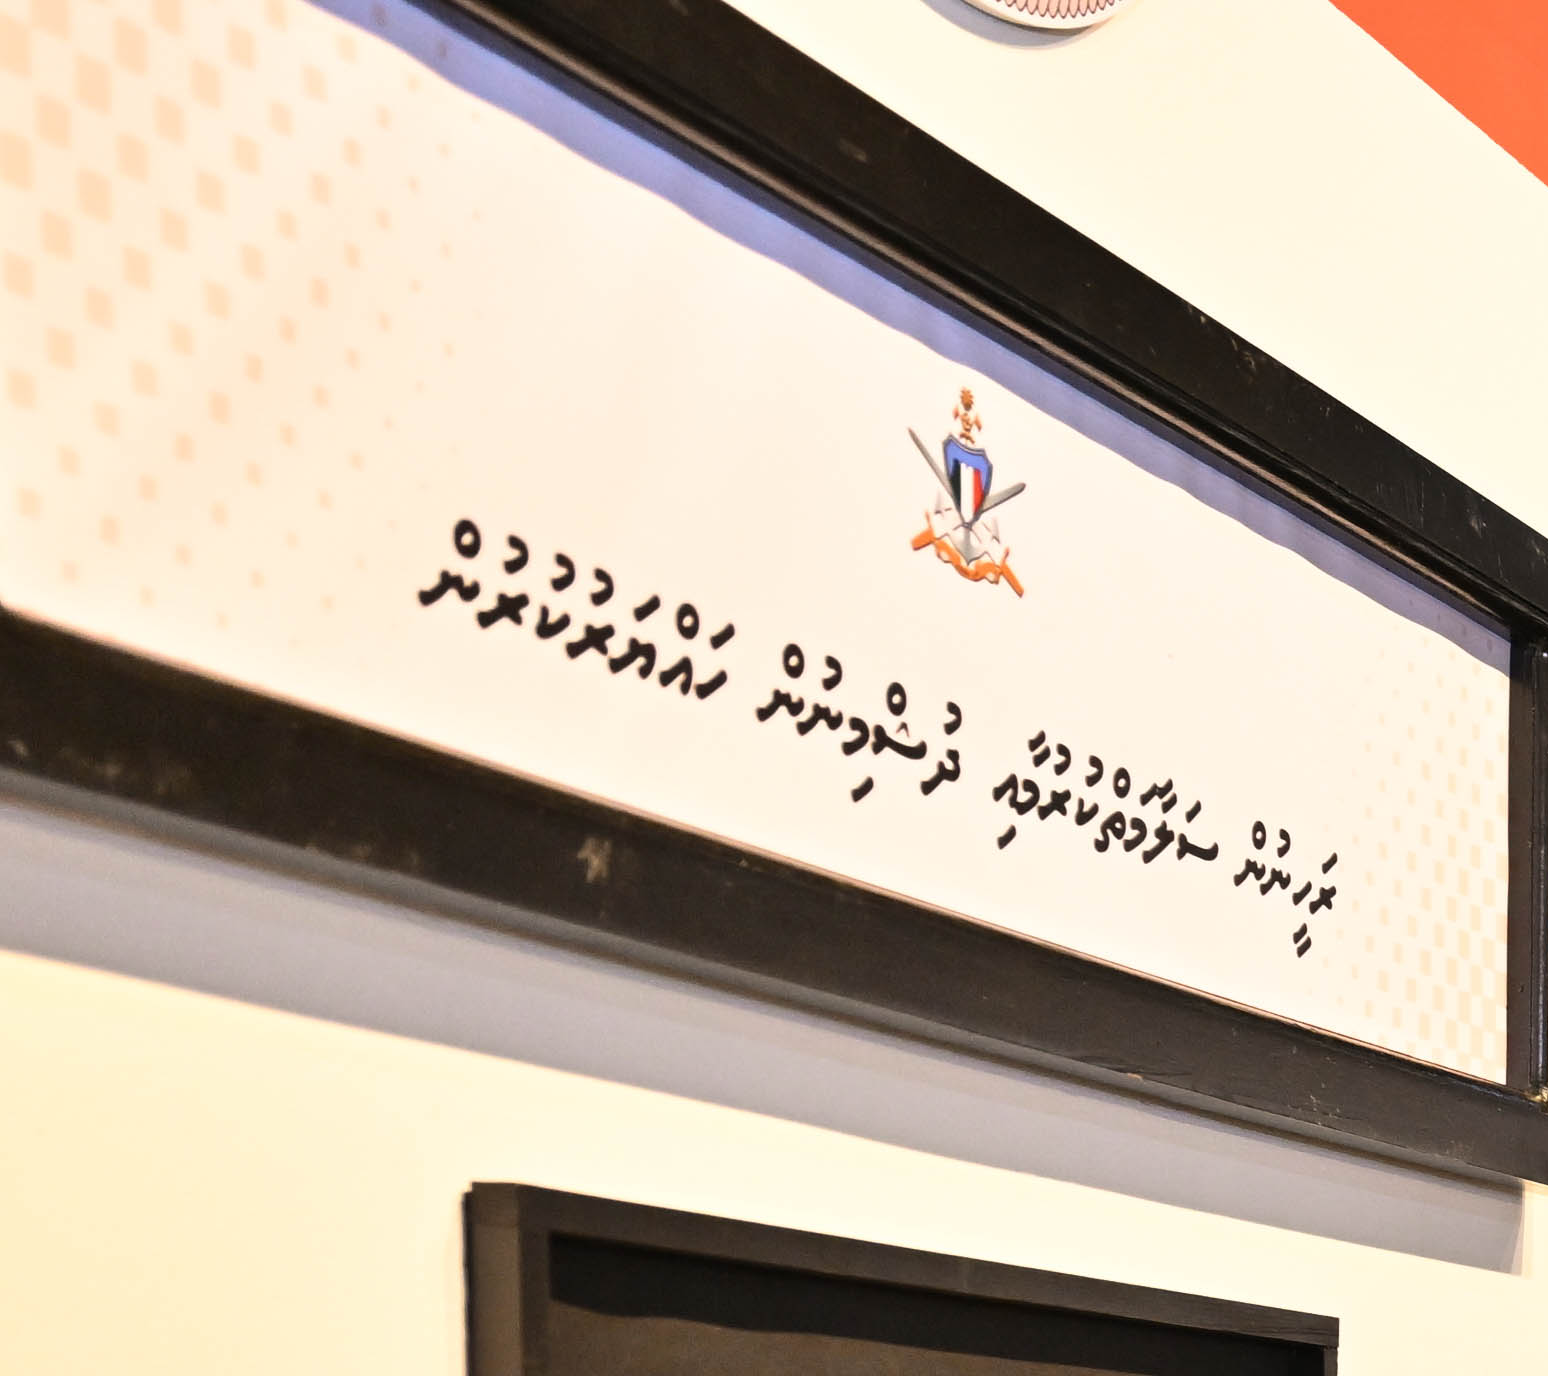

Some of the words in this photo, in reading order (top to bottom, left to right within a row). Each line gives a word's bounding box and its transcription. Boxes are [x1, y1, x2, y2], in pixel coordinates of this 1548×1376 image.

[419, 521, 734, 699] ހައްޔަރުކުރުން
[757, 644, 961, 802] ދުޝްމިނުން
[994, 733, 1218, 863] ސަލާމަތްކުރުމާއި
[1234, 821, 1337, 957] ރަހީނުން
